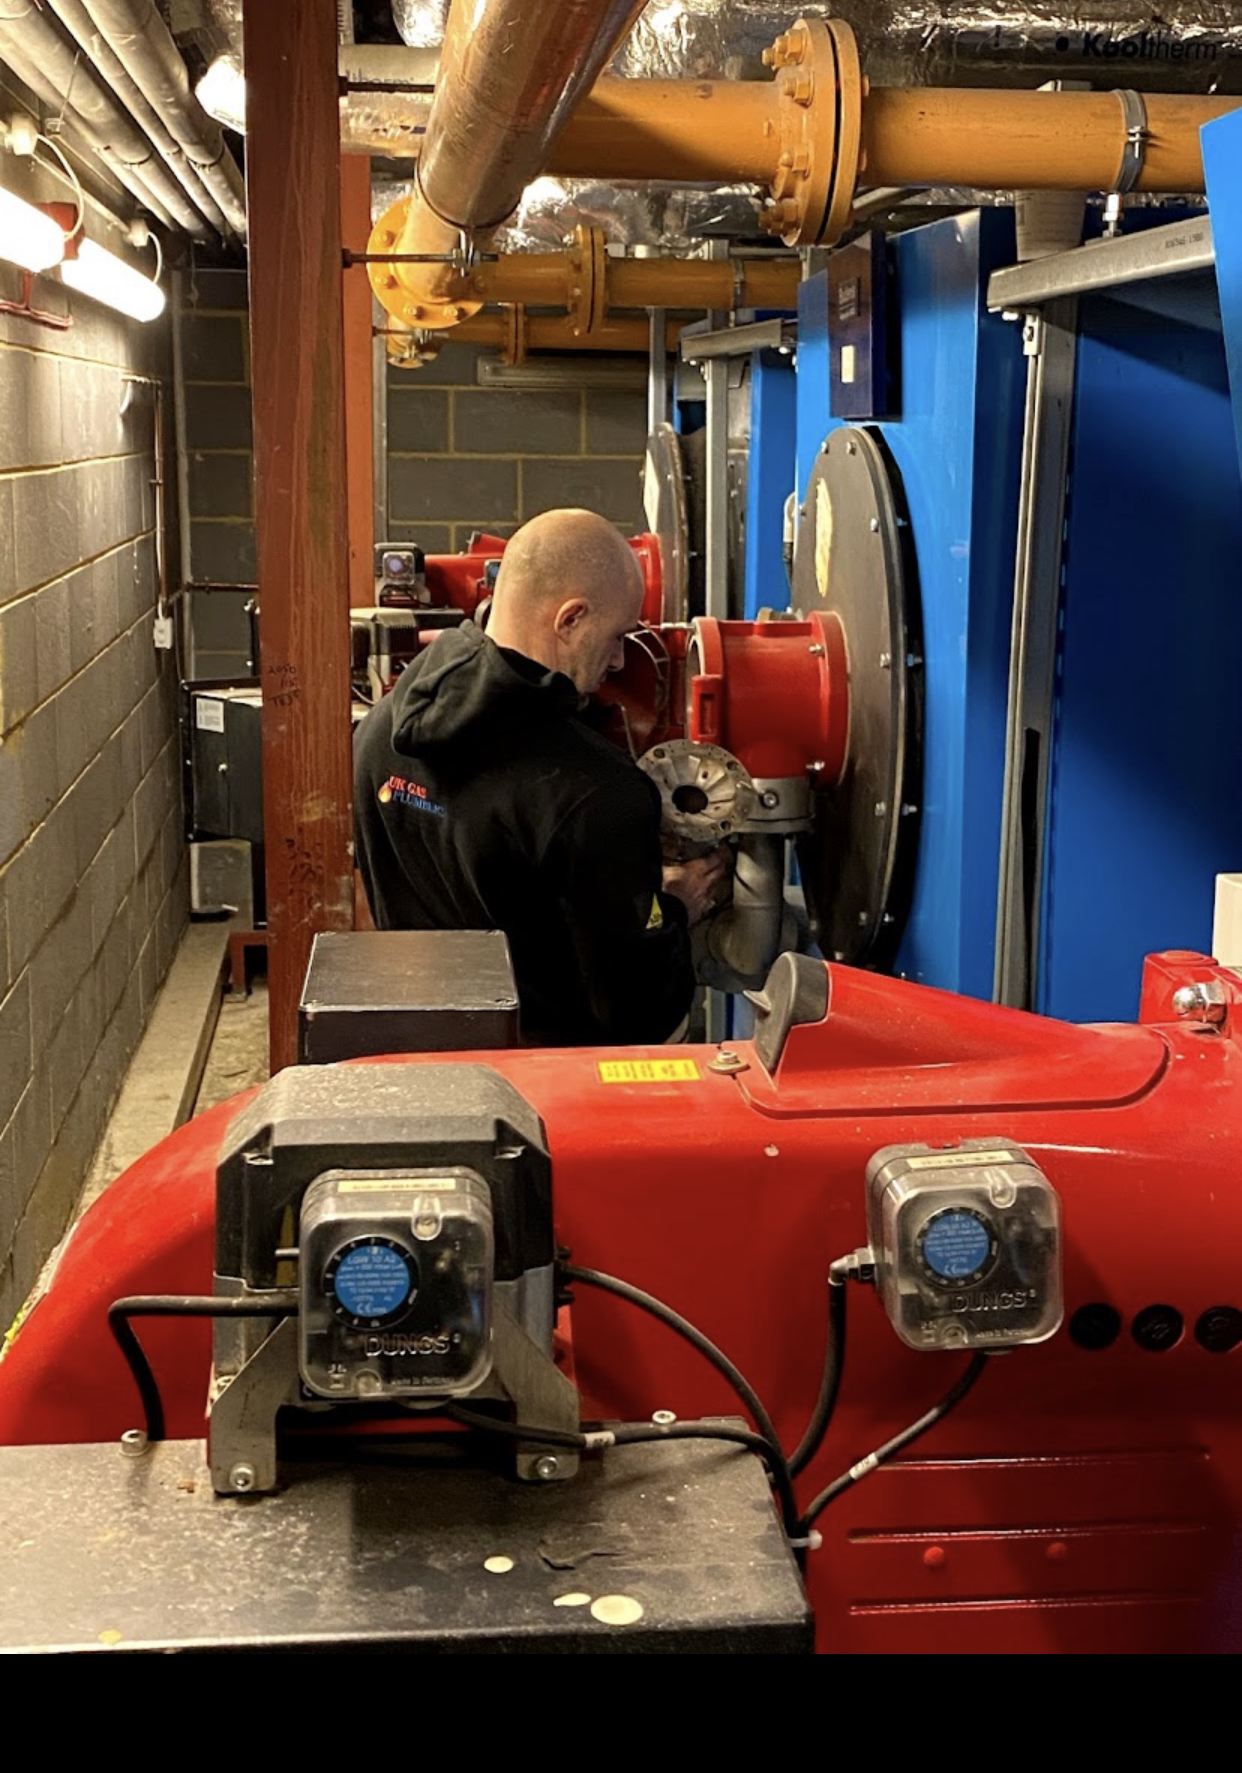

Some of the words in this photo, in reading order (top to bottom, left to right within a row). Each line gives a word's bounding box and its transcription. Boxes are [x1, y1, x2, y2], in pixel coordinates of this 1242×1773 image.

[1082, 31, 1217, 59] Kooltherm
[389, 775, 406, 791] UK
[407, 782, 427, 799] GAS
[951, 1291, 1027, 1313] DUNGS
[365, 1333, 450, 1357] DUNGS
